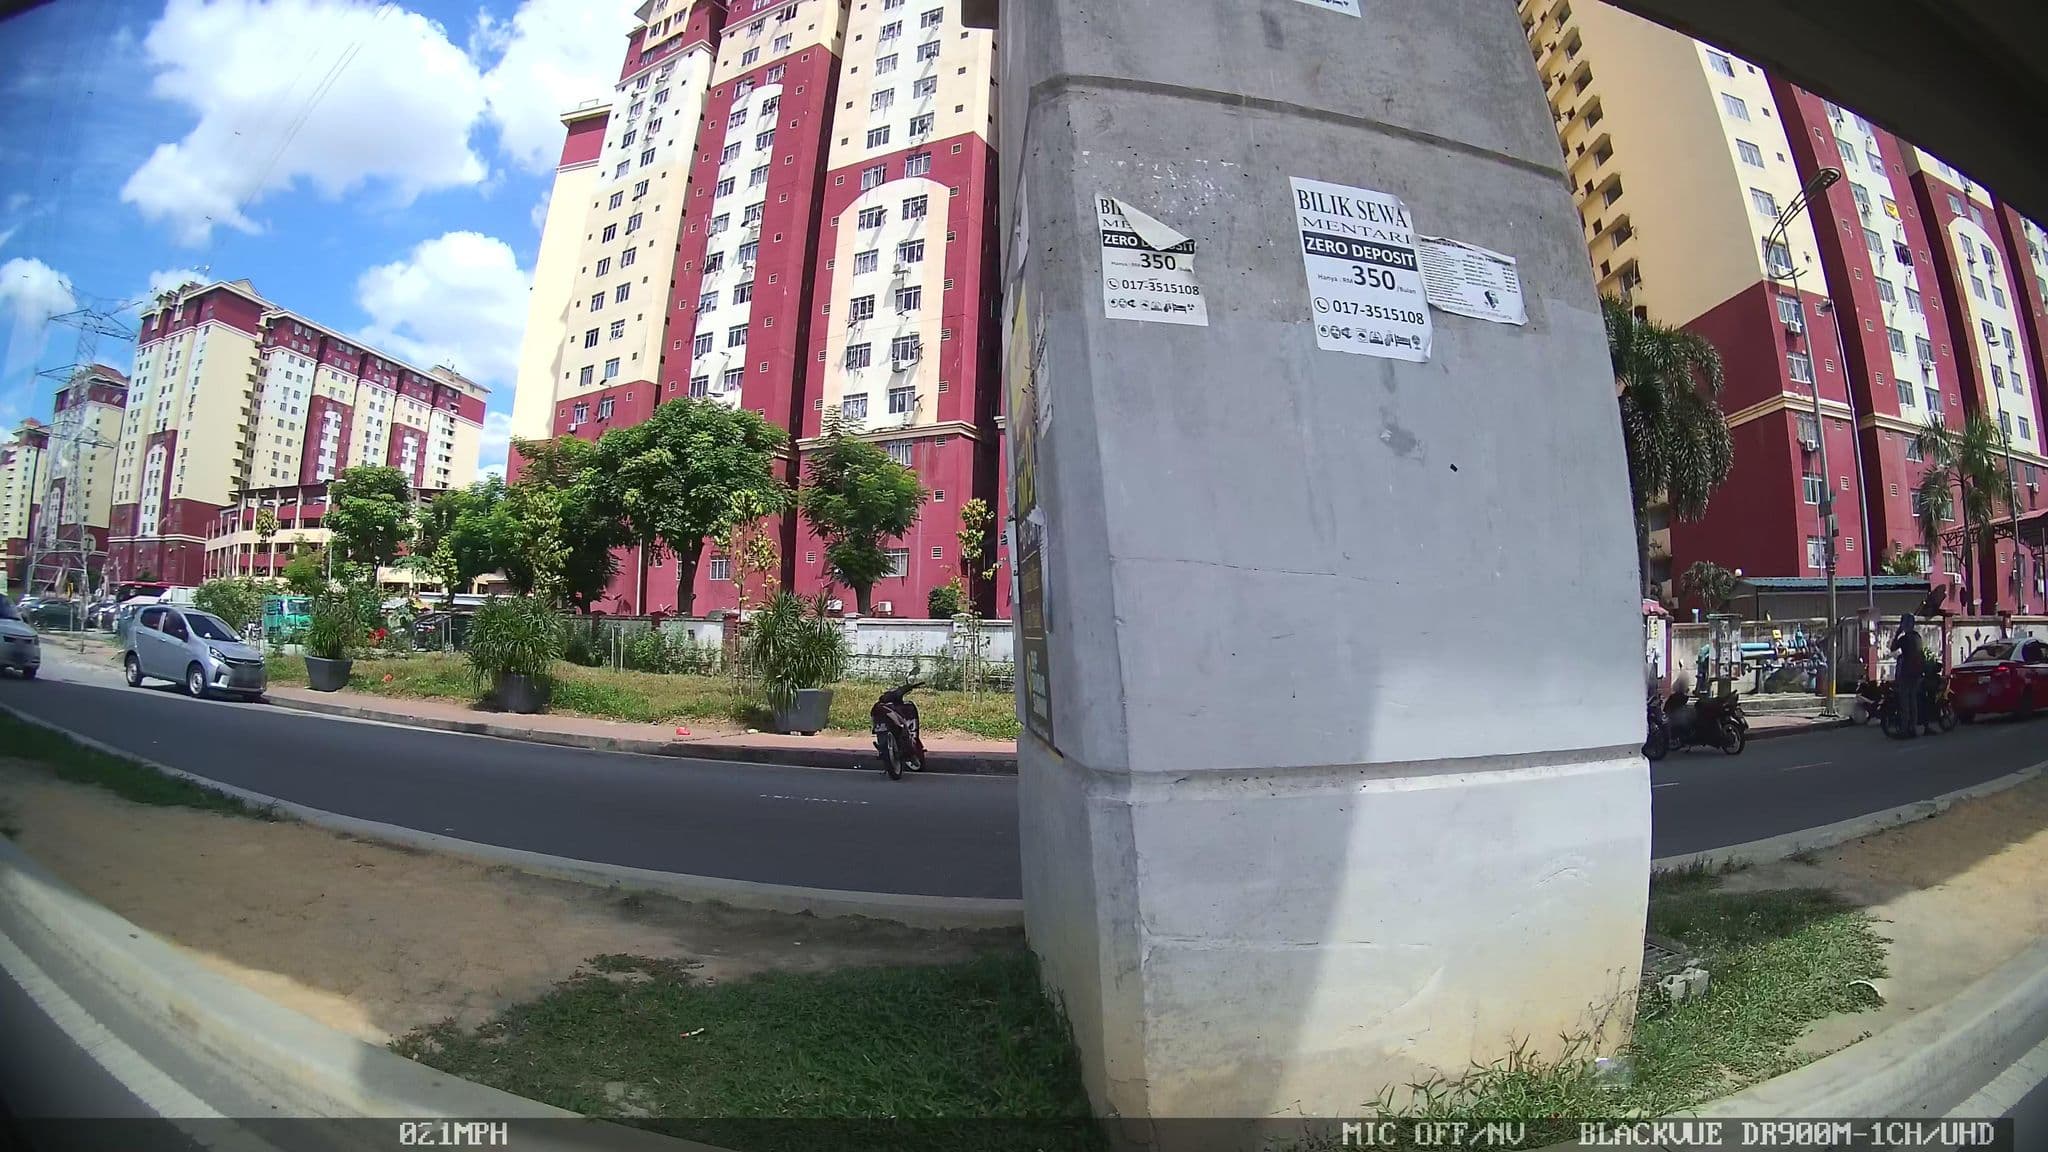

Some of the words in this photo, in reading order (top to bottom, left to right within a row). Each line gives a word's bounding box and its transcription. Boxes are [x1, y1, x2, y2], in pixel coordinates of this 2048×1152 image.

[1297, 189, 1353, 218] BILIK
[1356, 199, 1408, 228] SEWA
[1103, 234, 1138, 246] ZERO
[1302, 216, 1412, 244] MENTARI
[1140, 253, 1176, 271] 350
[1305, 236, 1348, 255] ZERO
[1352, 244, 1415, 267] DEPOSIT
[1121, 279, 1200, 296] 017-3515108
[1332, 299, 1425, 325] 017-3515108
